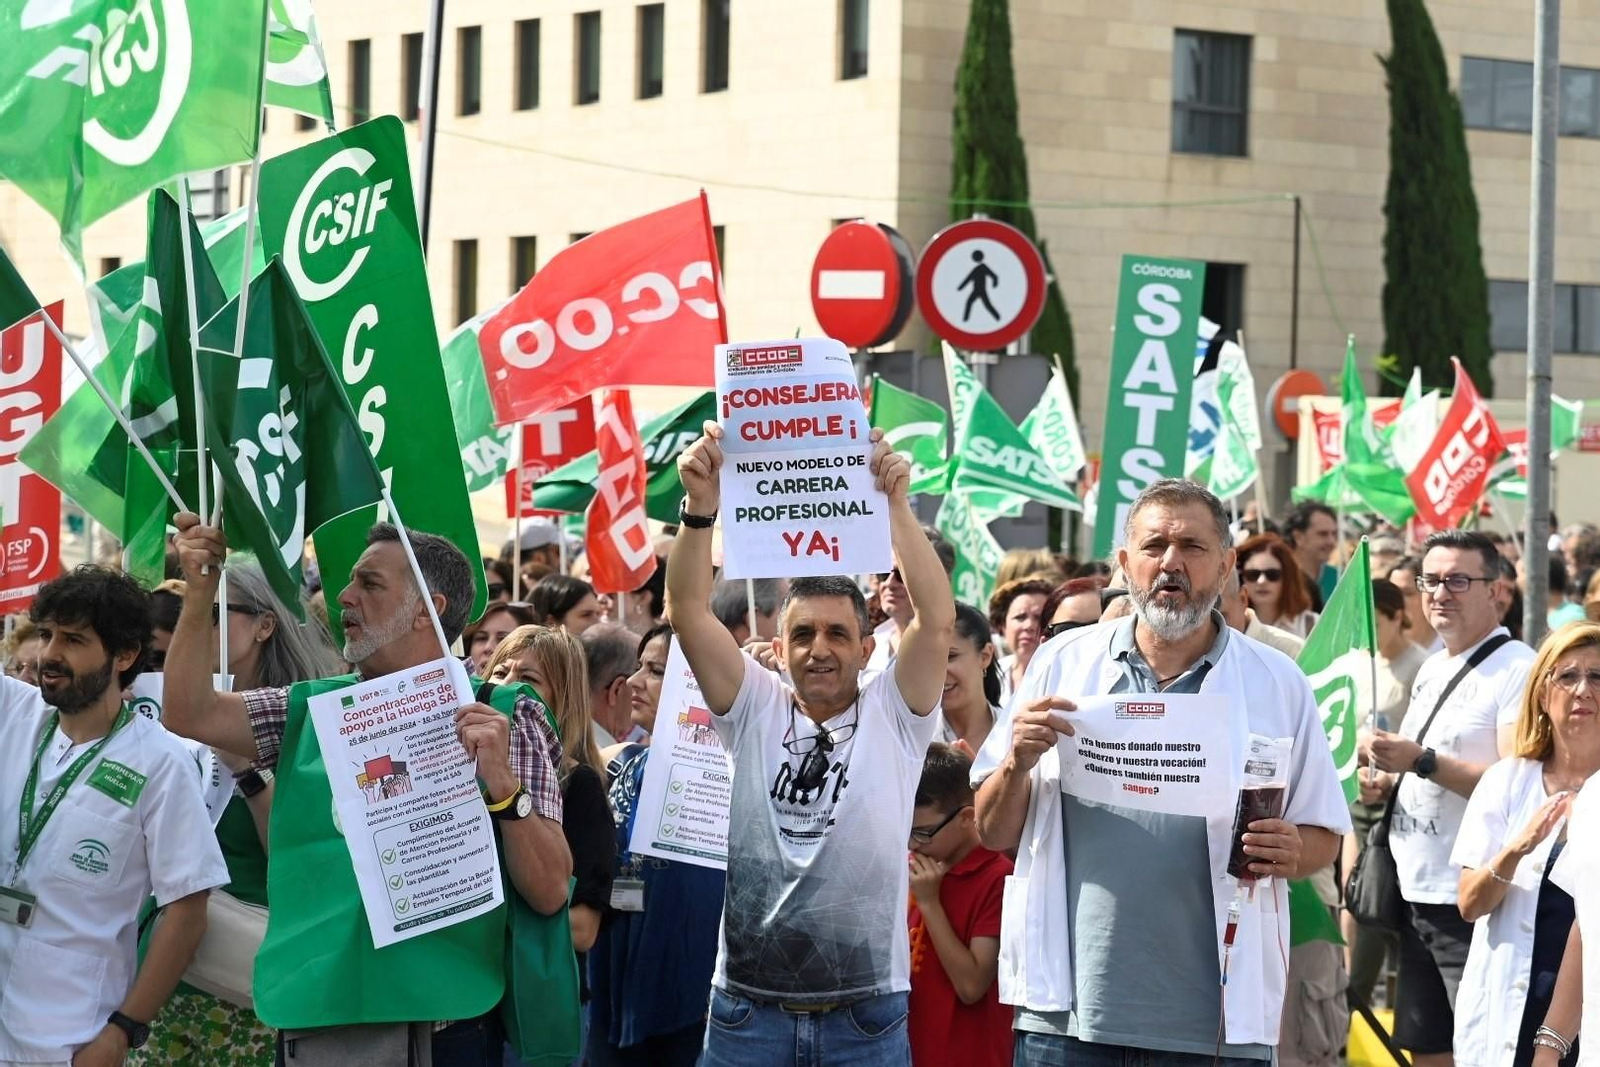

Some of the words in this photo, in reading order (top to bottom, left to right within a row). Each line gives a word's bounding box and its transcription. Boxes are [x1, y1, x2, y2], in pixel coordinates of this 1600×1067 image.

[305, 178, 393, 254] CSIF
[1132, 264, 1193, 279] CÓRDOBA
[746, 349, 788, 362] CCOO
[722, 382, 861, 418] ¡CONSEJERA
[342, 303, 393, 524] CSI
[1112, 283, 1182, 548] SATS
[740, 415, 844, 442] CUMPLE
[736, 461, 783, 474] NUEVO
[786, 456, 844, 470] MODELO
[847, 455, 866, 466] DE
[964, 434, 1056, 488] SATS
[756, 476, 849, 496] CARRERA
[736, 500, 874, 522] PROFESIONAL
[8, 538, 32, 557] FSP
[344, 688, 435, 722] Concentraciones
[437, 684, 452, 696] de
[1128, 704, 1156, 712] CCOO
[340, 718, 375, 736] apoyo
[385, 712, 397, 722] la
[398, 700, 438, 718] Huelga
[358, 733, 369, 744] de
[368, 728, 387, 742] junio
[388, 724, 398, 735] de
[399, 720, 417, 732] 2024
[404, 726, 444, 742] Convocamos
[414, 748, 426, 757] que
[674, 744, 697, 755] Participa
[702, 752, 726, 760] compart
[1081, 737, 1094, 747] ¡Ya
[1095, 740, 1126, 751] hemos
[1128, 742, 1163, 752] donado
[1164, 742, 1201, 752] nuestro
[420, 756, 428, 764] las
[429, 748, 452, 761] puertas
[672, 752, 693, 761] sociales
[1078, 748, 1114, 764] esfuerzo
[1116, 757, 1122, 766] y
[1122, 758, 1159, 767] nuestra
[1160, 757, 1206, 768] vocación!
[416, 762, 440, 773] centros
[424, 768, 444, 780] apoyo
[450, 770, 462, 778] SAS
[1084, 762, 1123, 777] ¿Quieres
[1124, 769, 1162, 782] también
[1164, 774, 1200, 784] nuestra
[104, 774, 128, 791] HUELGA
[686, 780, 726, 792] Cumplimiento
[1122, 783, 1160, 796] sangre?
[684, 794, 704, 804] Carrera
[694, 788, 718, 798] Atención
[366, 806, 393, 818] Participa
[398, 795, 430, 808] comparte
[429, 789, 447, 800] fotos
[366, 814, 392, 826] sociales
[392, 810, 405, 819] con
[405, 808, 412, 816] el
[412, 800, 439, 814] hashtag
[680, 805, 720, 818] Consolidación
[409, 811, 455, 832] EXIGIMOS
[688, 815, 714, 824] plantillas
[396, 828, 444, 848] Cumplimiento
[444, 824, 457, 834] del
[457, 815, 482, 829] Acuerdo
[399, 848, 408, 856] de
[409, 840, 440, 854] Atención
[439, 830, 468, 844] Primaria
[472, 825, 480, 833] de
[675, 832, 697, 842] Empleo
[698, 836, 725, 847] Temporal
[678, 826, 716, 838] Actualización
[402, 852, 427, 864] Carrera
[427, 840, 466, 856] Profesional
[404, 858, 452, 878] Consolidación
[458, 848, 484, 860] aumento
[406, 878, 416, 886] las
[417, 868, 450, 884] plantillas
[412, 880, 458, 900] Actualización
[458, 877, 468, 886] de
[468, 874, 476, 882] la
[476, 869, 490, 880] Bolsa
[413, 896, 440, 909] Empleo
[440, 884, 474, 900] Temporal
[474, 880, 483, 889] del
[482, 876, 493, 886] SAS
